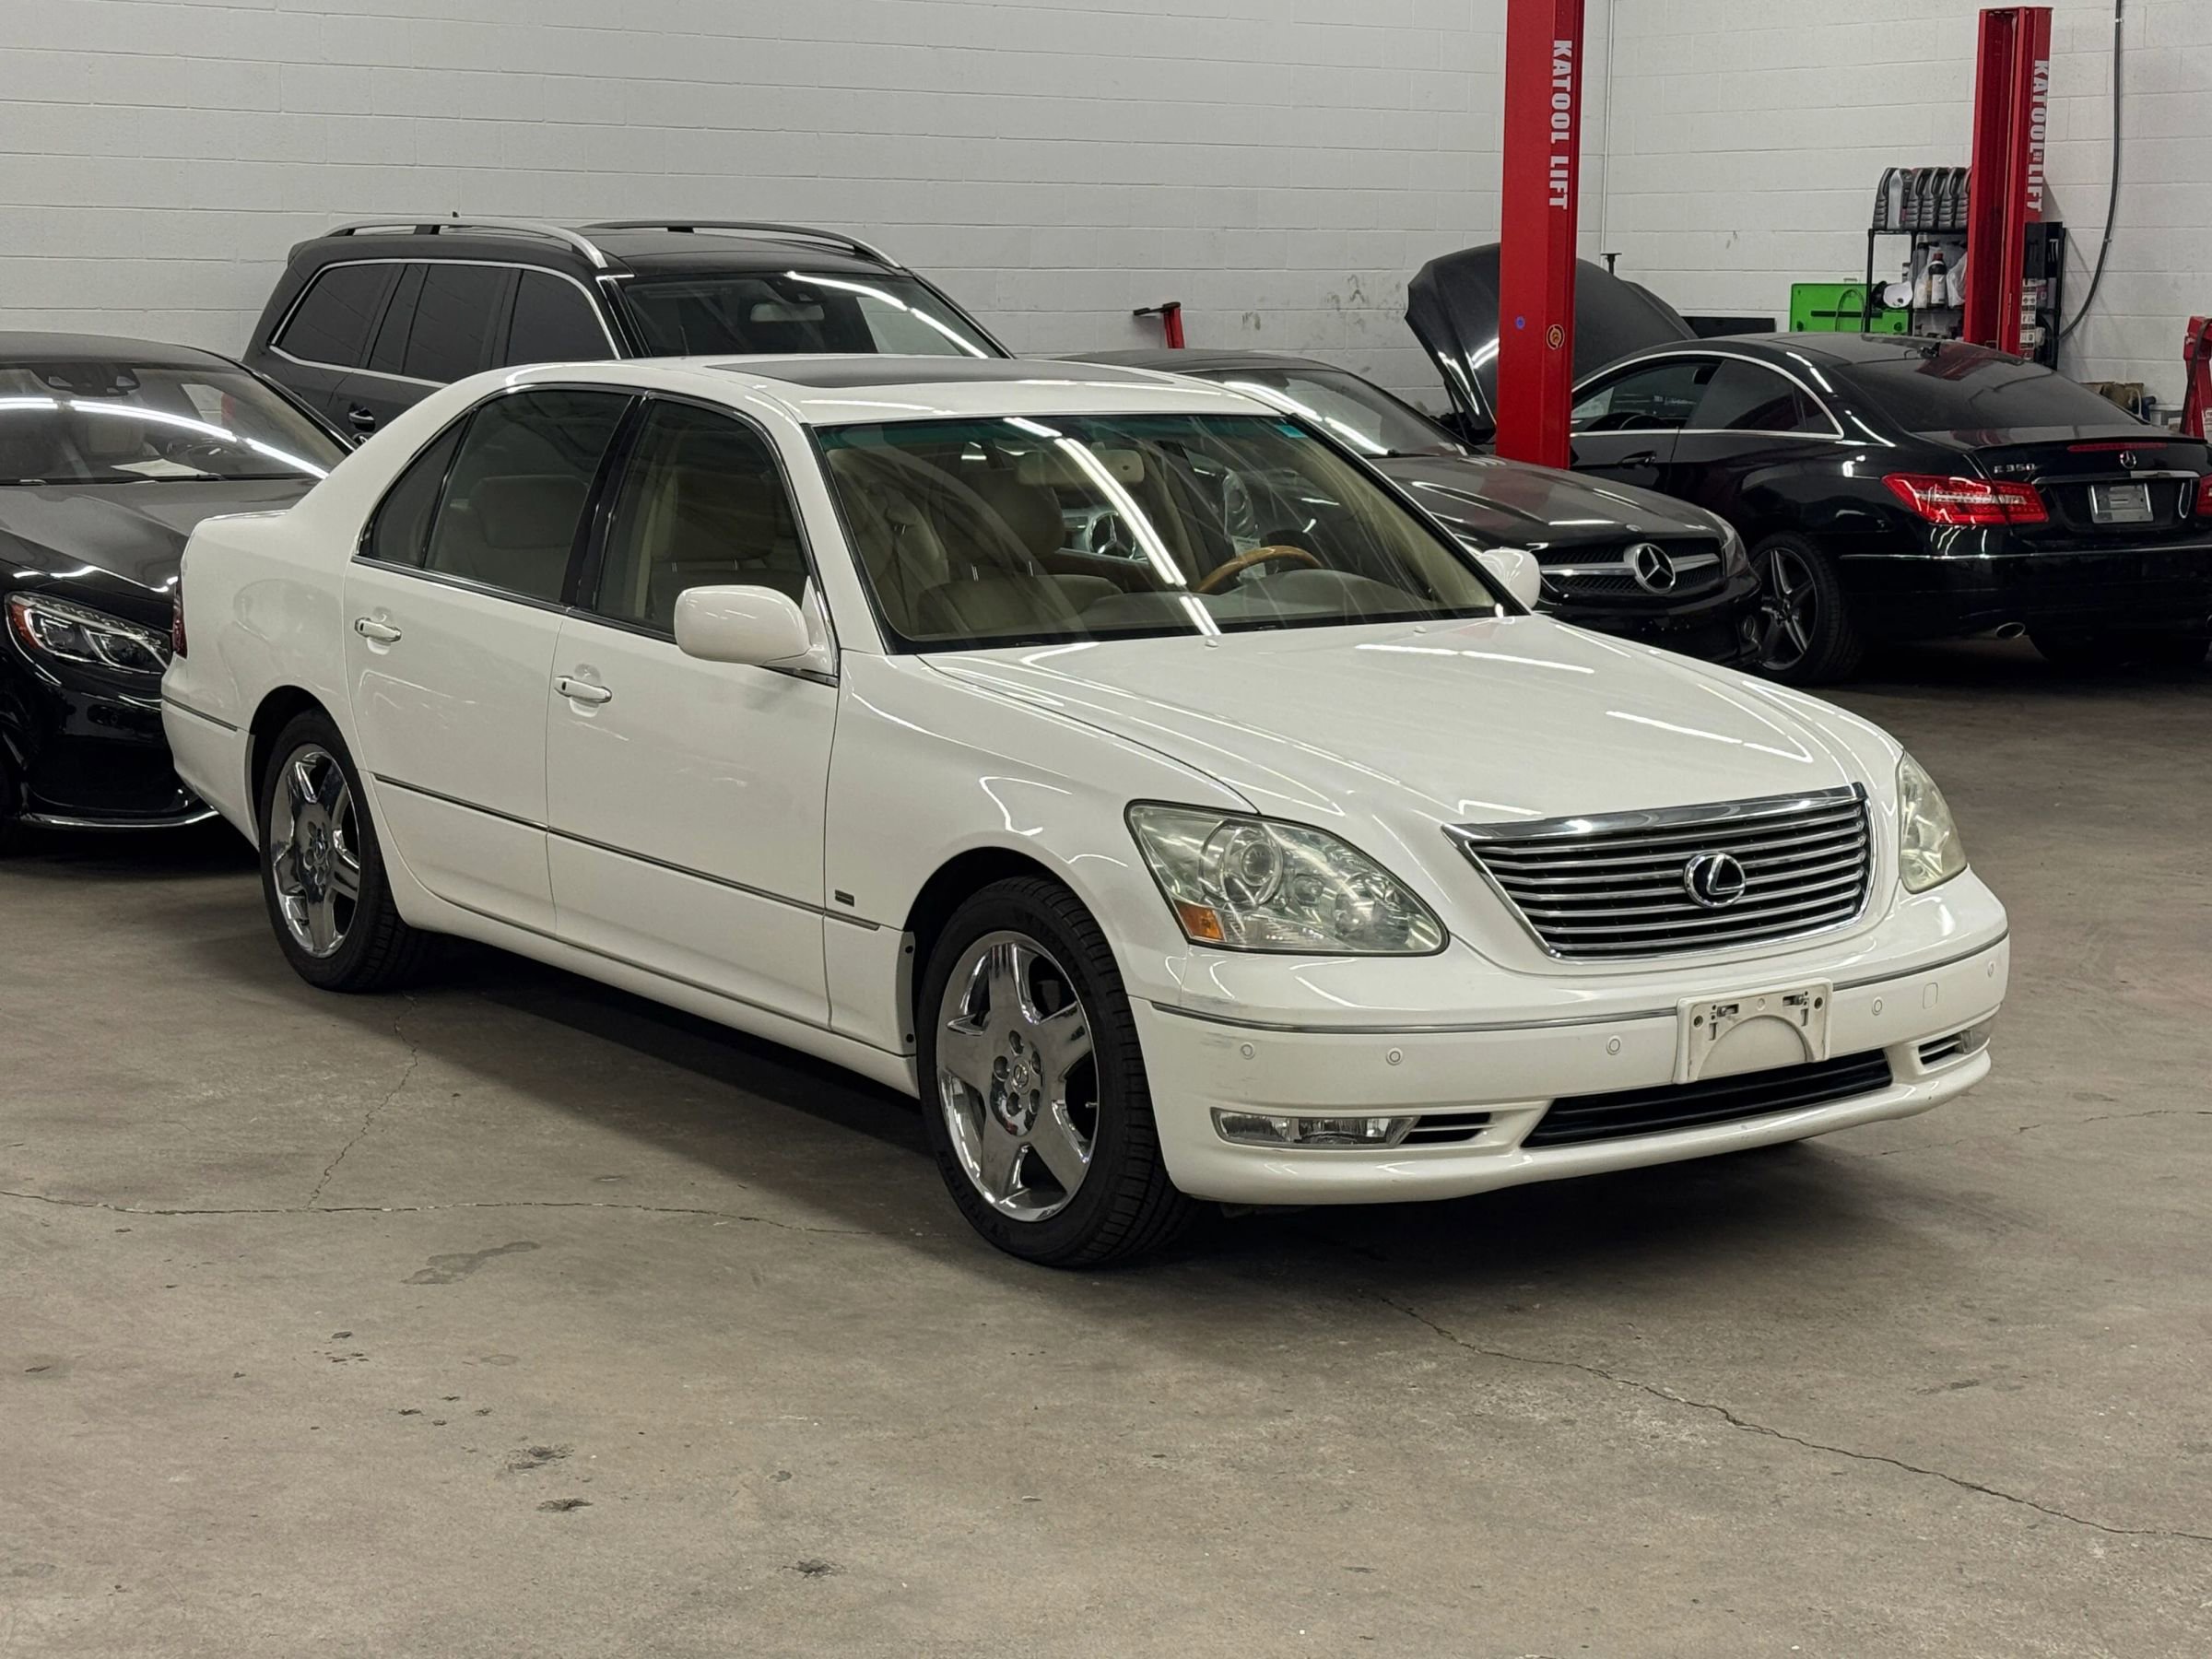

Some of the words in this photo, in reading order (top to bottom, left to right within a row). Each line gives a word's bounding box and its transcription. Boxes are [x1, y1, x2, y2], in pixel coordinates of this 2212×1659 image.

[1550, 40, 1572, 145] KATOOL
[2030, 60, 2049, 153] KATOOL
[1548, 155, 1569, 210] LIFT
[2027, 163, 2043, 213] LIFT
